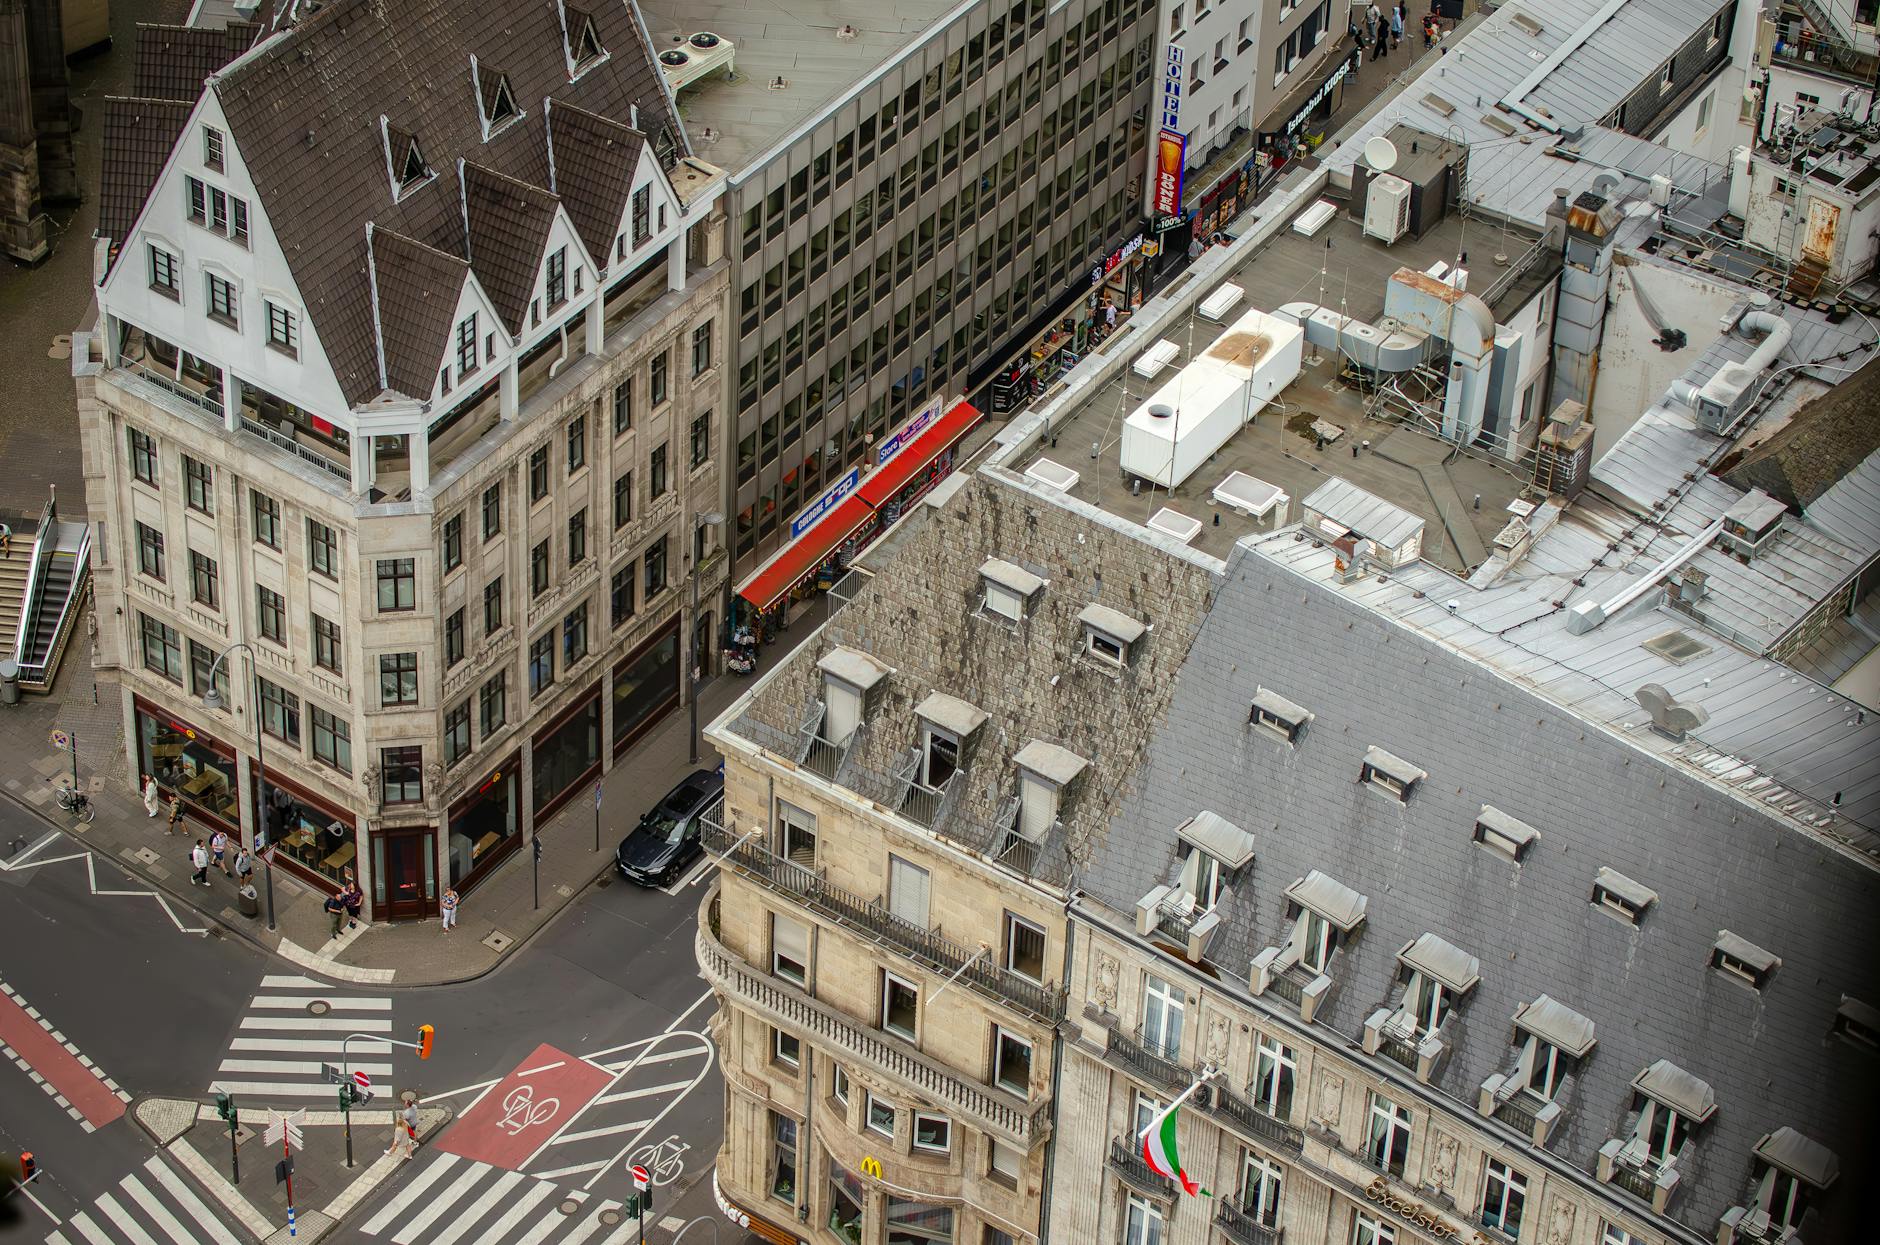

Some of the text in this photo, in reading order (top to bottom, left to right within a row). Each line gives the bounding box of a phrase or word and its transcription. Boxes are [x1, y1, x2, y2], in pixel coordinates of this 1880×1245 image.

[1165, 46, 1182, 128] HOTEL
[1287, 88, 1323, 135] Istanbul
[880, 441, 898, 460] Store
[798, 502, 824, 530] COLOGNE
[1365, 1179, 1457, 1240] Excelsior
